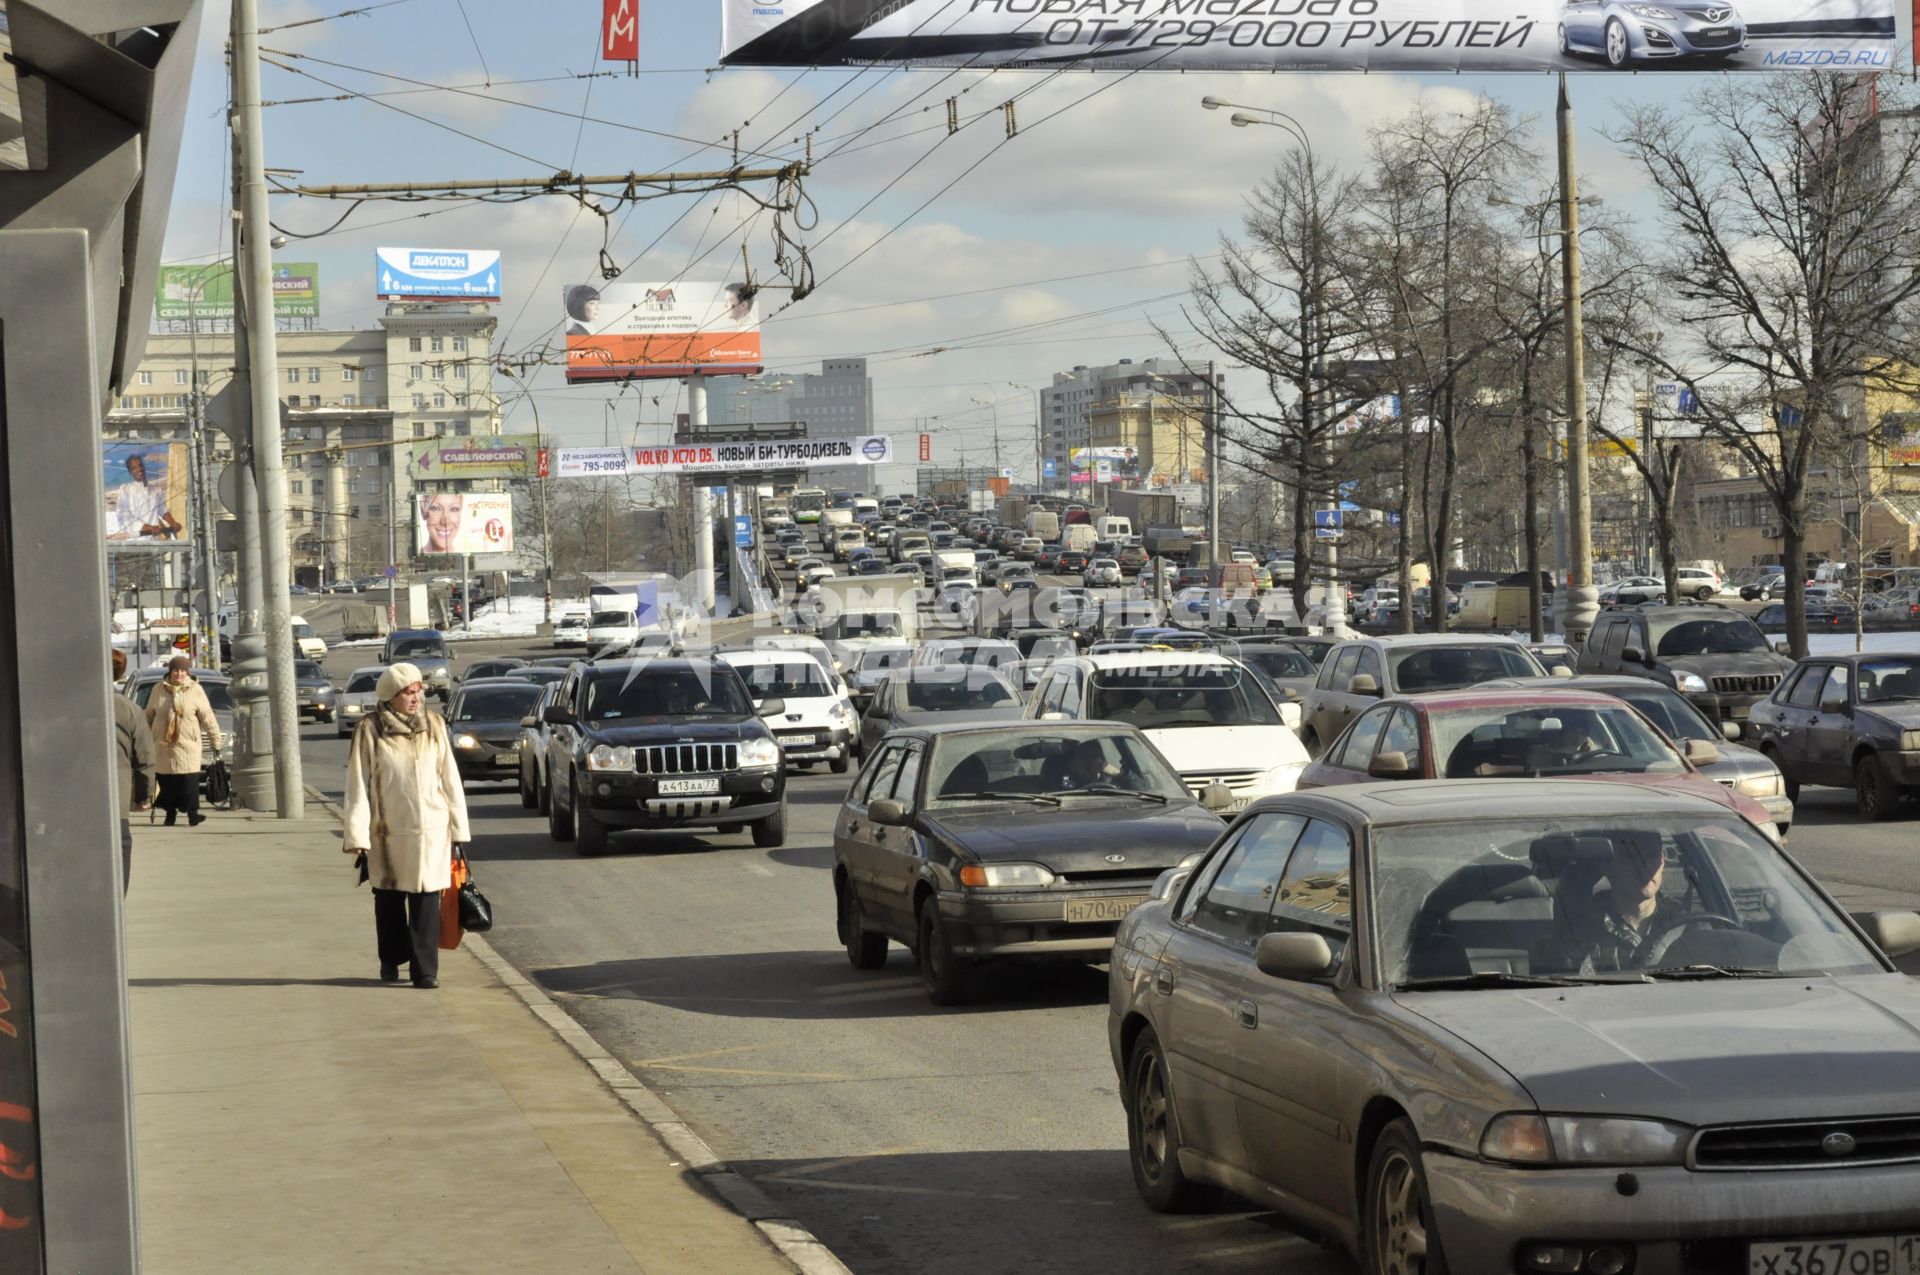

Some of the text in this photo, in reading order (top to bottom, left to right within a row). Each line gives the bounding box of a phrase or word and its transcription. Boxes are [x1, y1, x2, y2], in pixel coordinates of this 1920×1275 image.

[1043, 15, 1538, 49] ОТ 729 000 РУБЛЕЙ
[635, 449, 669, 465] VOLVO
[672, 448, 696, 464] XC70
[717, 444, 756, 463] НОВЫЙ
[758, 441, 852, 461] БИ-ТУРБОДИЗЕЛЬ
[583, 460, 626, 472] 795-0099
